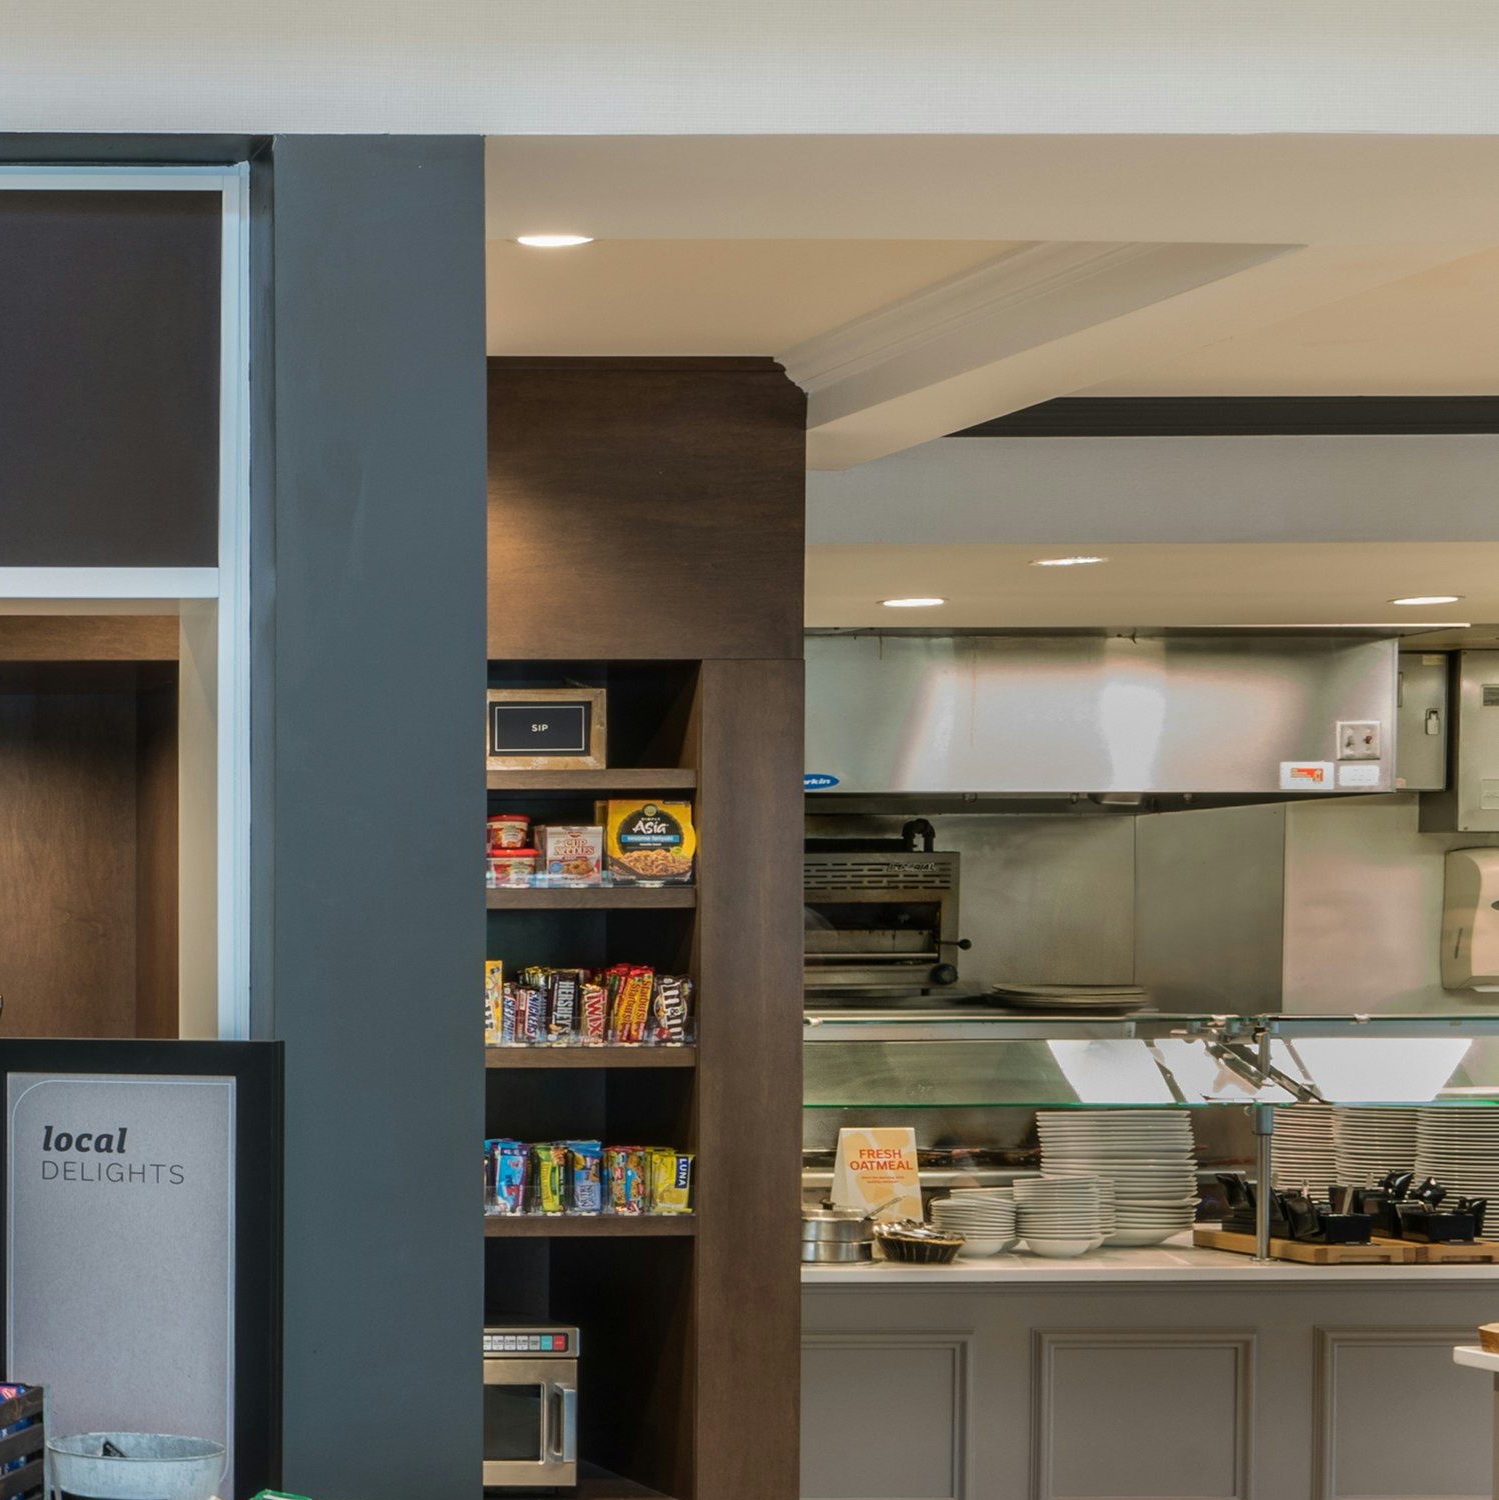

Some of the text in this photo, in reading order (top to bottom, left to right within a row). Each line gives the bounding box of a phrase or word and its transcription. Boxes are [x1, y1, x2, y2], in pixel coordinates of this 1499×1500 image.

[531, 723, 549, 733] SIP
[632, 820, 669, 835] Asia
[554, 846, 594, 856] NOODLES
[526, 989, 539, 1038] SNICKERS
[557, 981, 575, 1035] HERSHEY'S
[585, 992, 603, 1037] TWIX
[623, 982, 640, 1025] Starburst
[636, 979, 651, 1025] Starburst
[42, 1125, 128, 1154] local
[859, 1149, 902, 1159] FRESH
[41, 1160, 185, 1185] DELIGHTS
[677, 1157, 688, 1188] LUNA
[849, 1160, 913, 1171] OATMEAL
